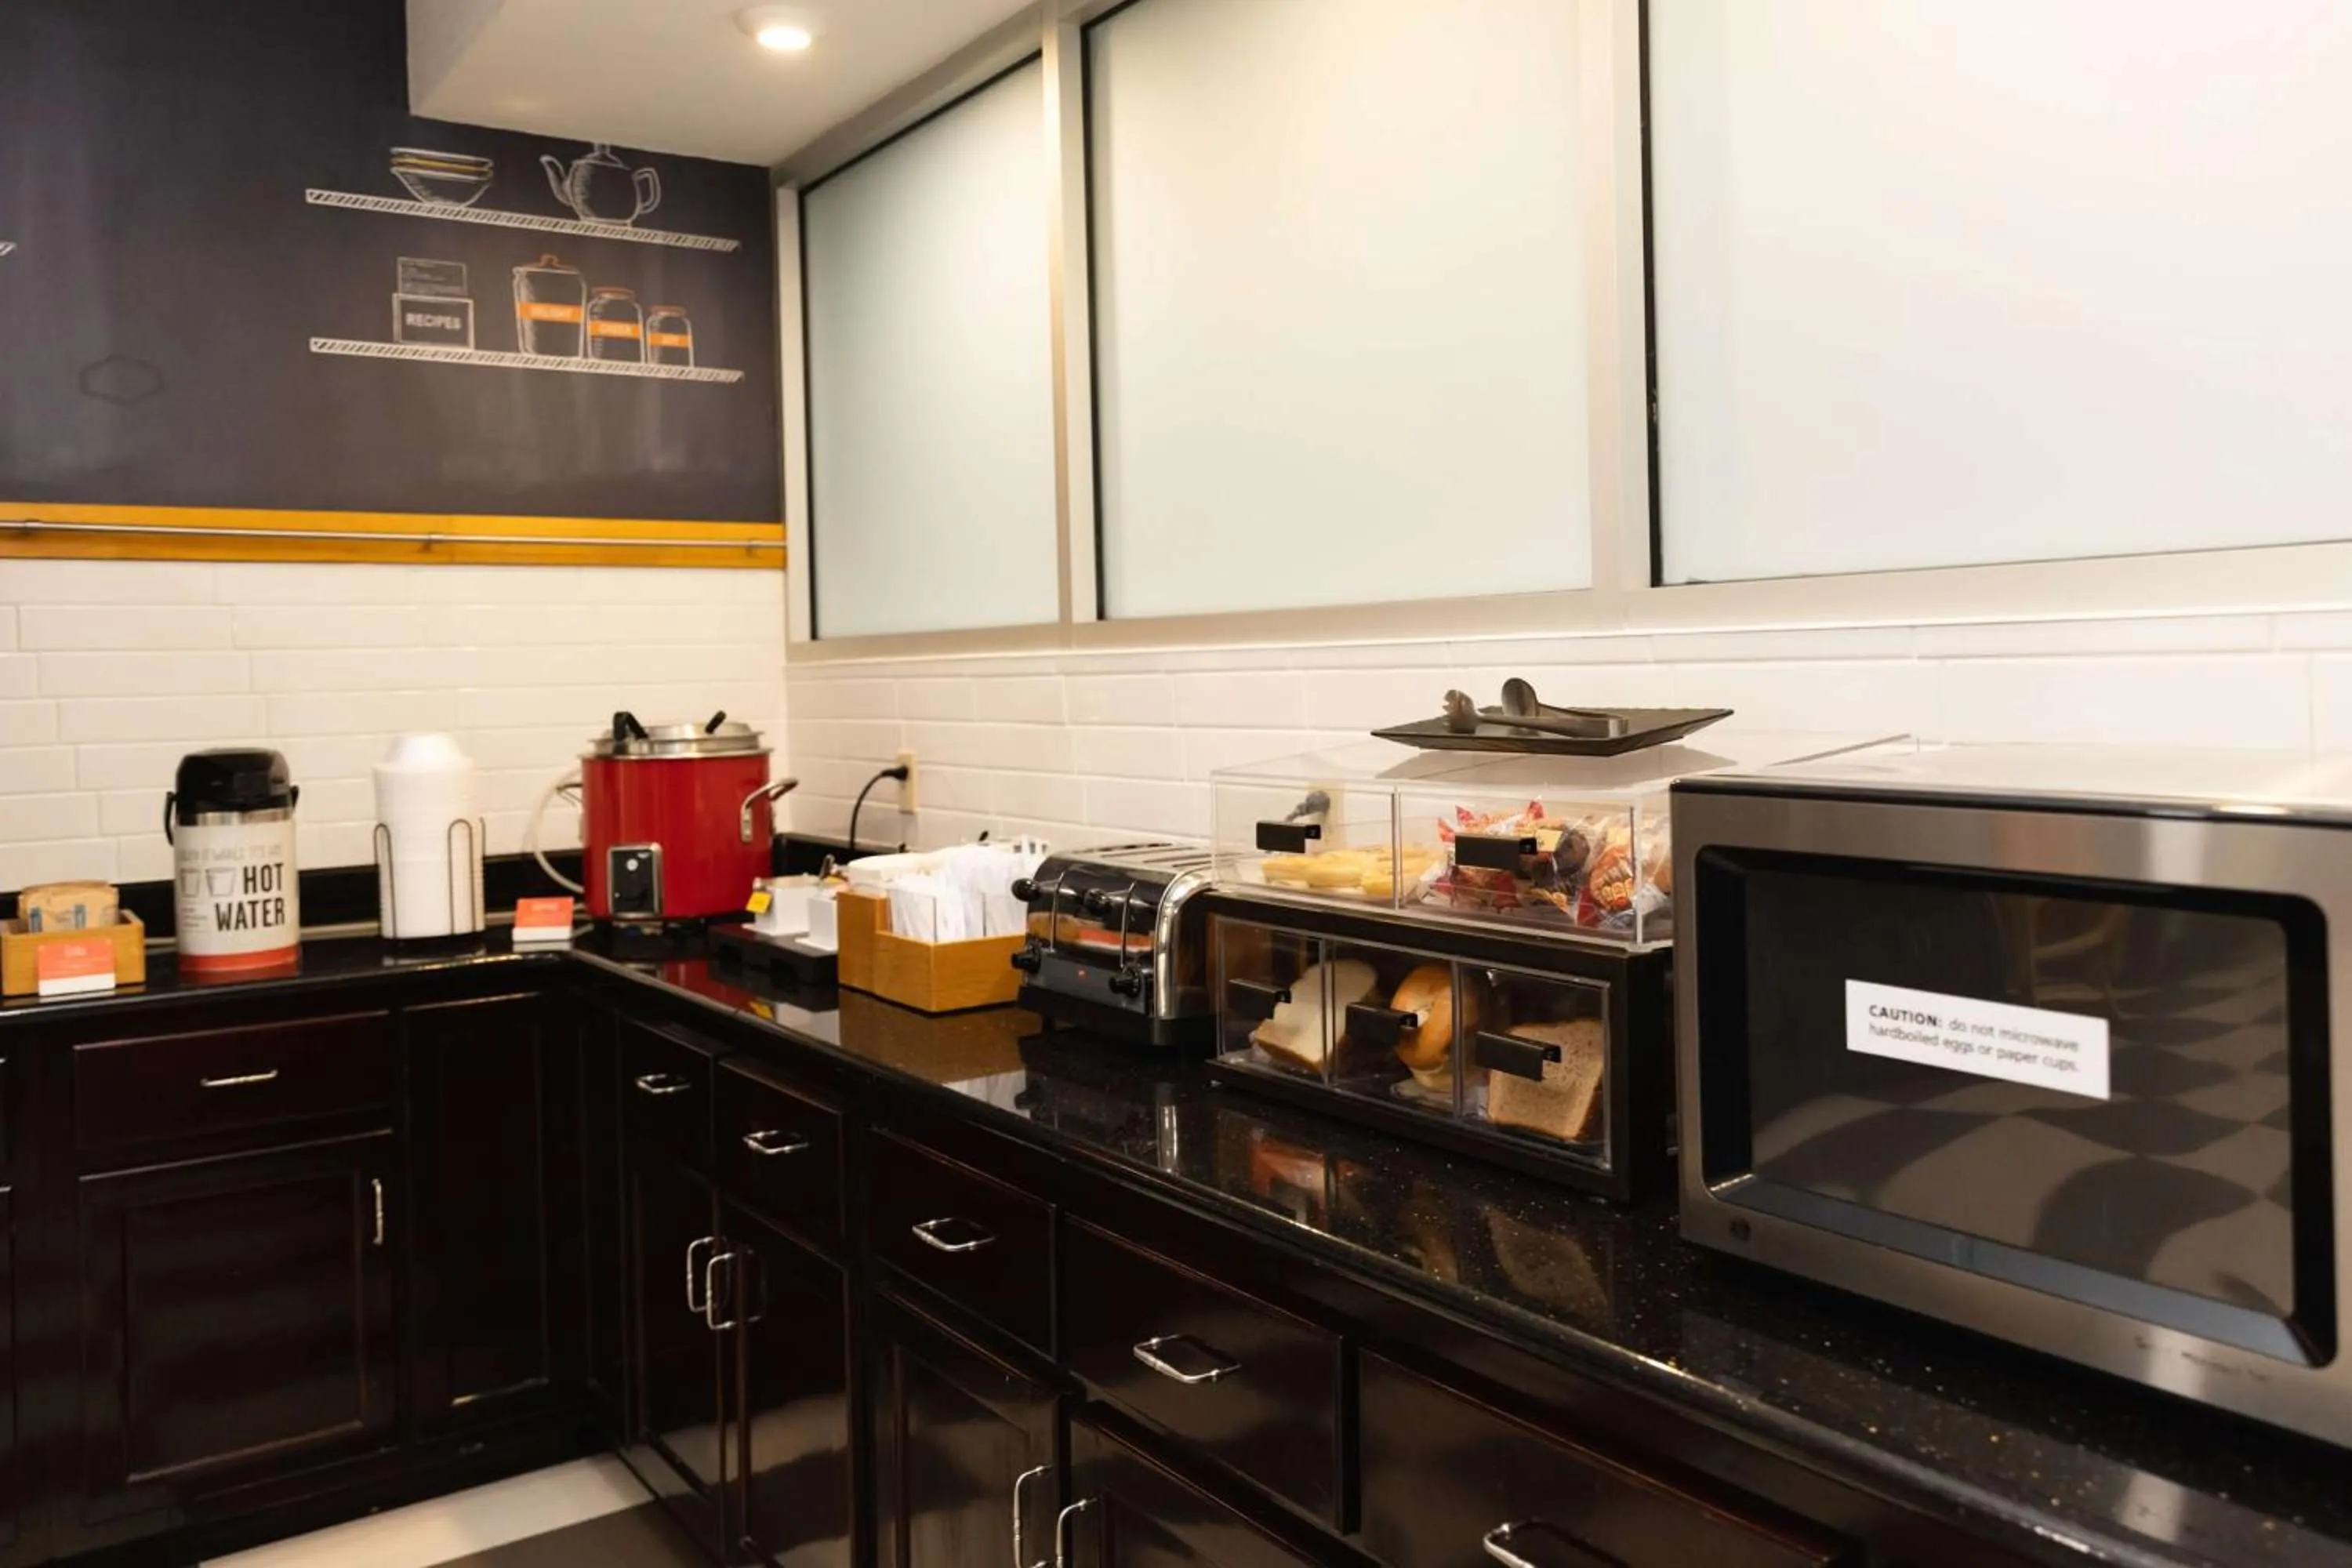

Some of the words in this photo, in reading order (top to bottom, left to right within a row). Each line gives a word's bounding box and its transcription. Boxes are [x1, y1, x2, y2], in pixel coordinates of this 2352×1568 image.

[405, 313, 461, 330] RECIPES
[243, 862, 283, 895] HOT
[215, 897, 285, 931] WATER
[1868, 1004, 1942, 1029] CAUTION:
[1948, 1018, 1967, 1032] do
[1970, 1024, 1994, 1036] not
[1998, 1028, 2079, 1052] microwave
[1868, 1022, 1939, 1047] hardboiled
[1943, 1038, 1975, 1054] eggs
[1977, 1044, 1993, 1055] or
[1997, 1047, 2038, 1064] paper
[2042, 1055, 2079, 1072] cups.
